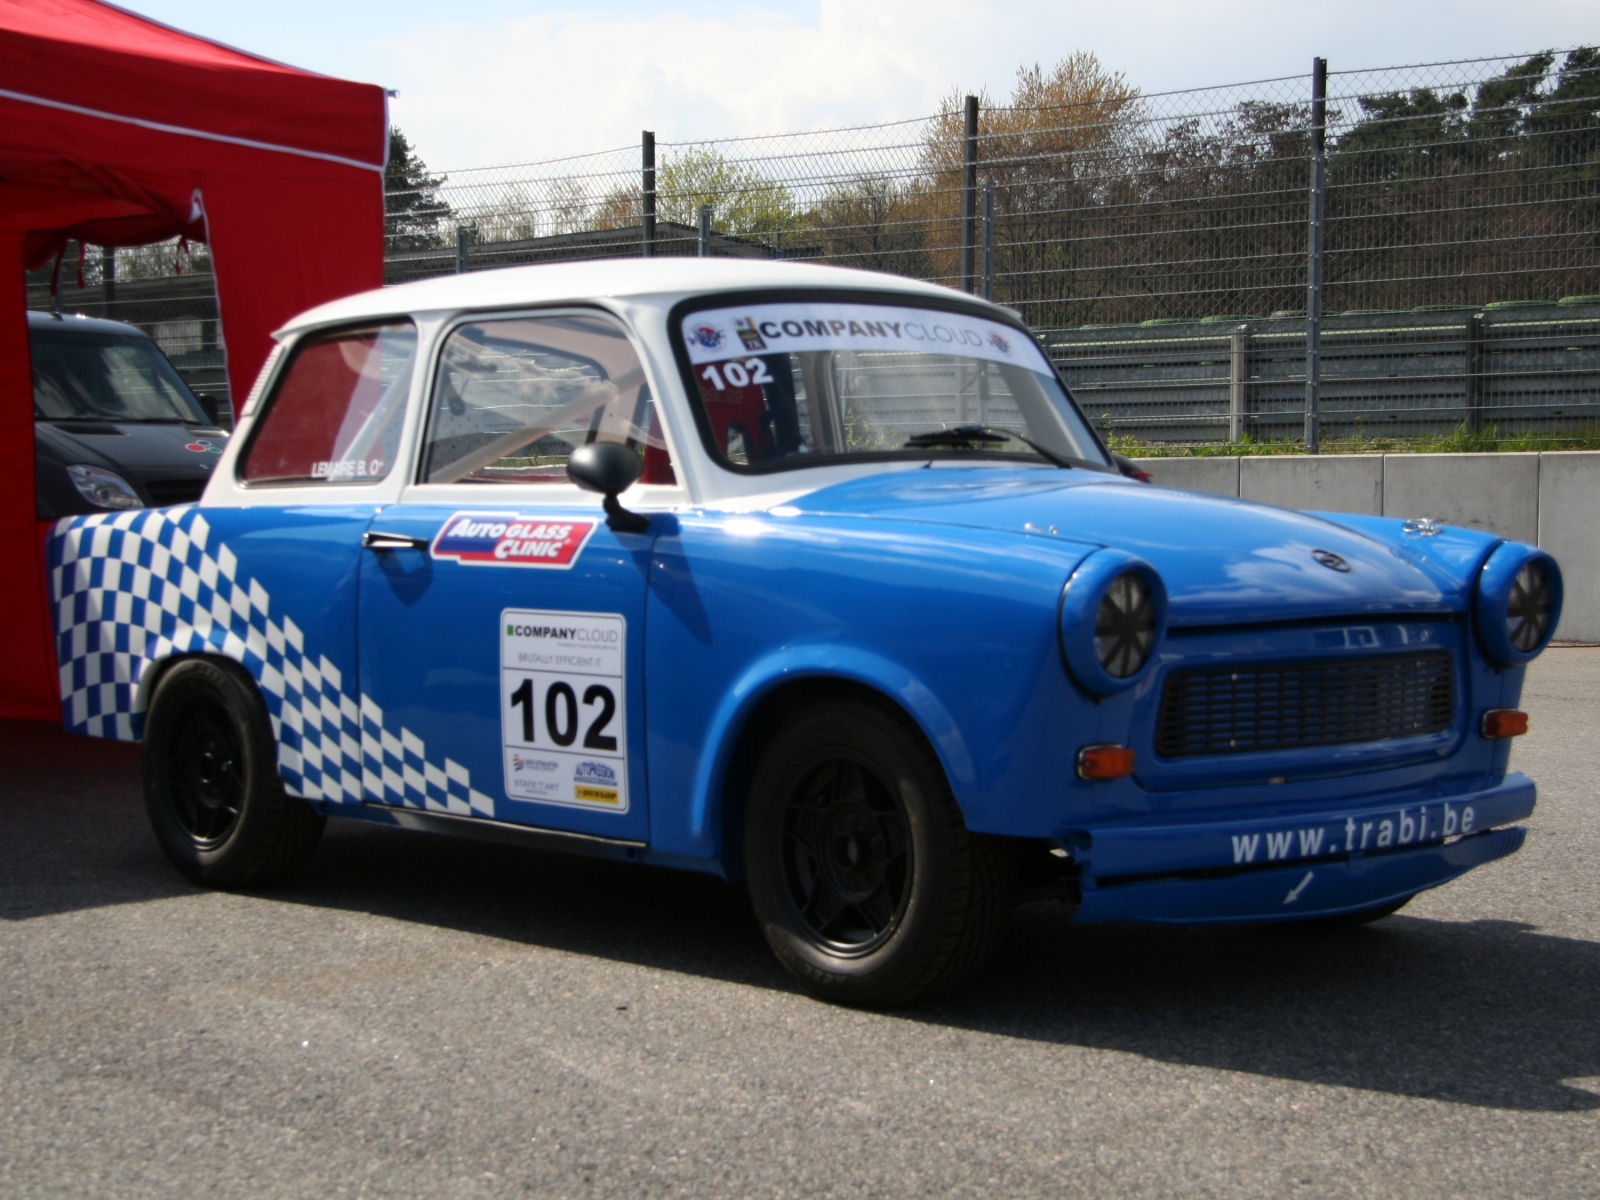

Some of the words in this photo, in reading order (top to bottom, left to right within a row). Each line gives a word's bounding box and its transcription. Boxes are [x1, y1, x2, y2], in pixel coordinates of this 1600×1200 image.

[759, 317, 983, 348] COMPANYCLOUD
[701, 358, 774, 391] 102
[494, 540, 563, 559] CLINIC
[514, 625, 618, 643] COMPANYCLOUD
[518, 652, 553, 664] BRUTALLY
[555, 655, 593, 667] EFFICIENT
[511, 678, 618, 751] 102
[575, 762, 615, 780] AUTOPASSION
[582, 789, 618, 800] DUNLOP
[1231, 802, 1476, 863] www.trabi.be
